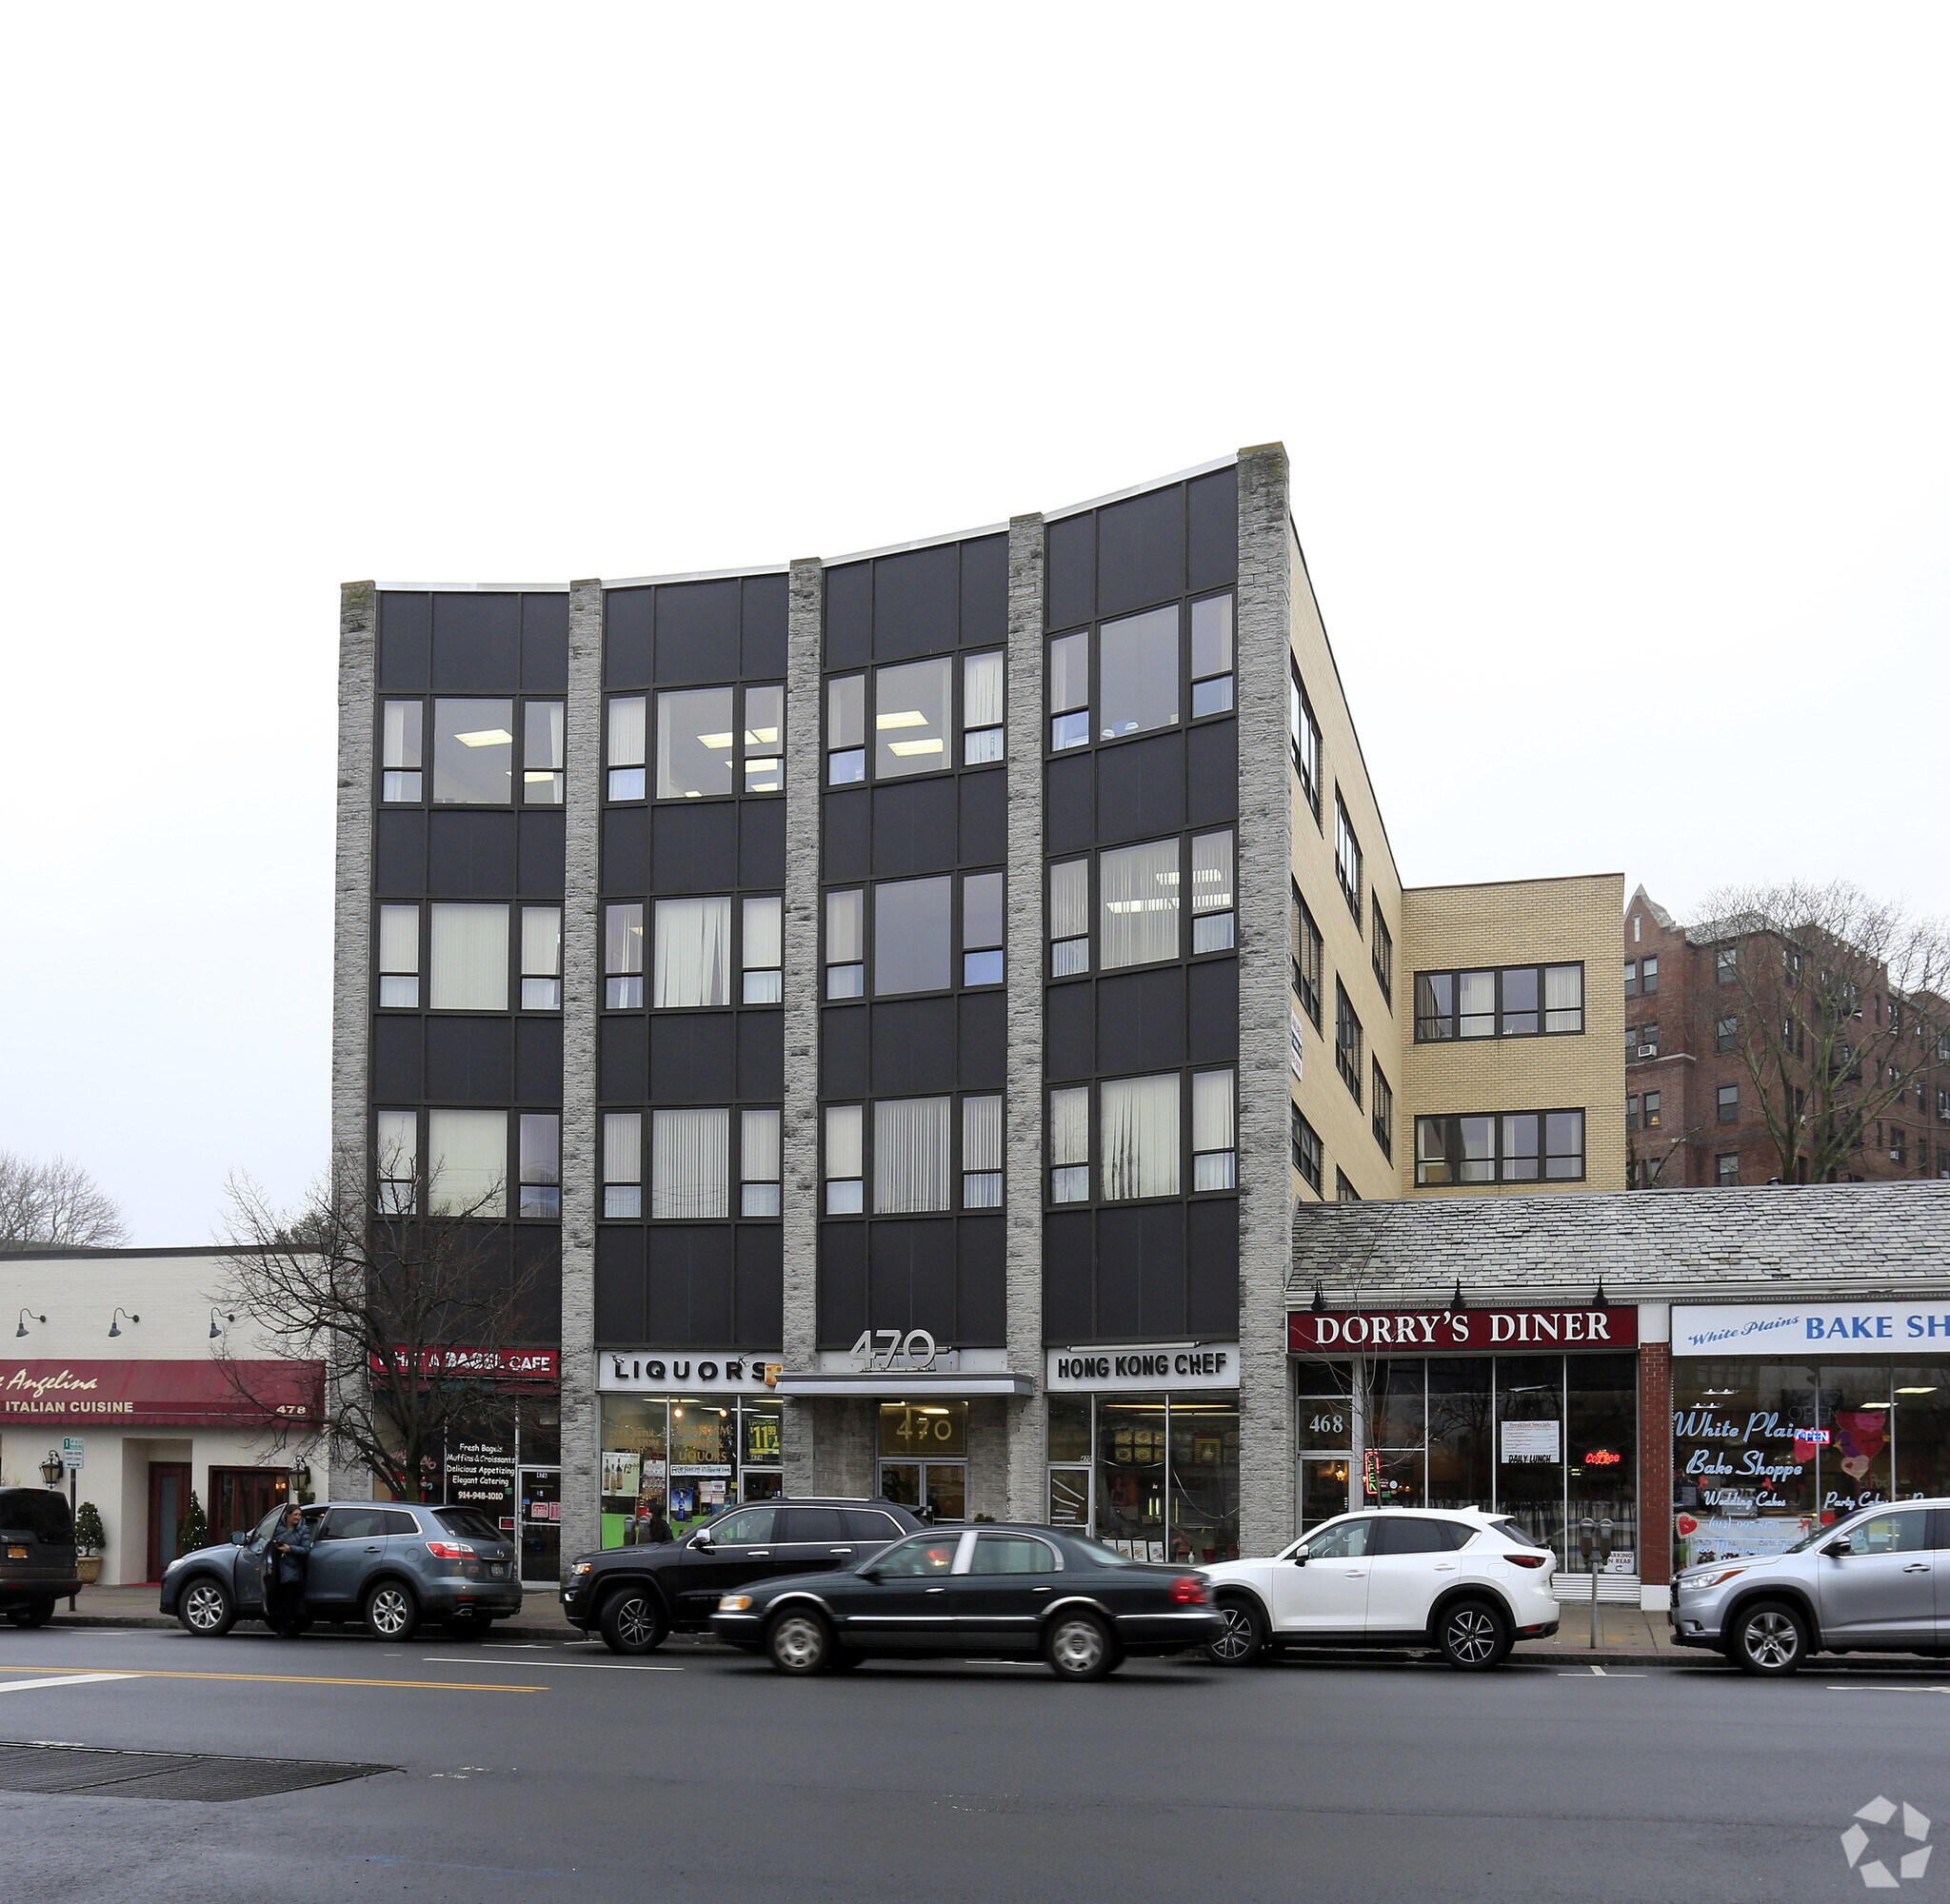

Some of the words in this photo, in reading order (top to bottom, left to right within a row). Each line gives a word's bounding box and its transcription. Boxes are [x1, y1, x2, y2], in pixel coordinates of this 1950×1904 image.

[1314, 1311, 1470, 1344] DORRY'S
[1489, 1311, 1611, 1342] DINER
[1688, 1329, 1739, 1346] White
[1741, 1316, 1800, 1336] Plains
[1806, 1316, 1893, 1339] BAKE
[849, 1329, 936, 1369] 470
[508, 1356, 550, 1372] CAFE
[614, 1359, 766, 1379] LIQUORS
[1058, 1357, 1110, 1378] HONG
[1115, 1355, 1169, 1377] KONG
[1174, 1353, 1227, 1375] CHEF
[6, 1368, 98, 1398] Angelina
[5, 1400, 66, 1413] ITALIAN
[70, 1401, 133, 1413] CUISINE
[276, 1405, 307, 1415] 478
[896, 1418, 952, 1440] 470
[1309, 1414, 1343, 1434] 468
[1673, 1411, 1740, 1438] White
[459, 1442, 480, 1453] Fresh
[481, 1443, 503, 1454] Bagels
[679, 1451, 727, 1462] LIQUORS
[446, 1453, 474, 1462] Muffins
[480, 1455, 516, 1464] Croissants
[1685, 1449, 1734, 1476] Bake
[1735, 1450, 1803, 1482] Shoppe
[446, 1464, 477, 1474] Delicious
[478, 1466, 515, 1477] Appetizing
[452, 1475, 479, 1485] Elegant
[480, 1476, 509, 1487] Catering
[458, 1490, 504, 1500] 914-948-1010
[1703, 1490, 1753, 1511] Wedding
[1755, 1490, 1787, 1507] Cakes
[1823, 1491, 1856, 1511] Party
